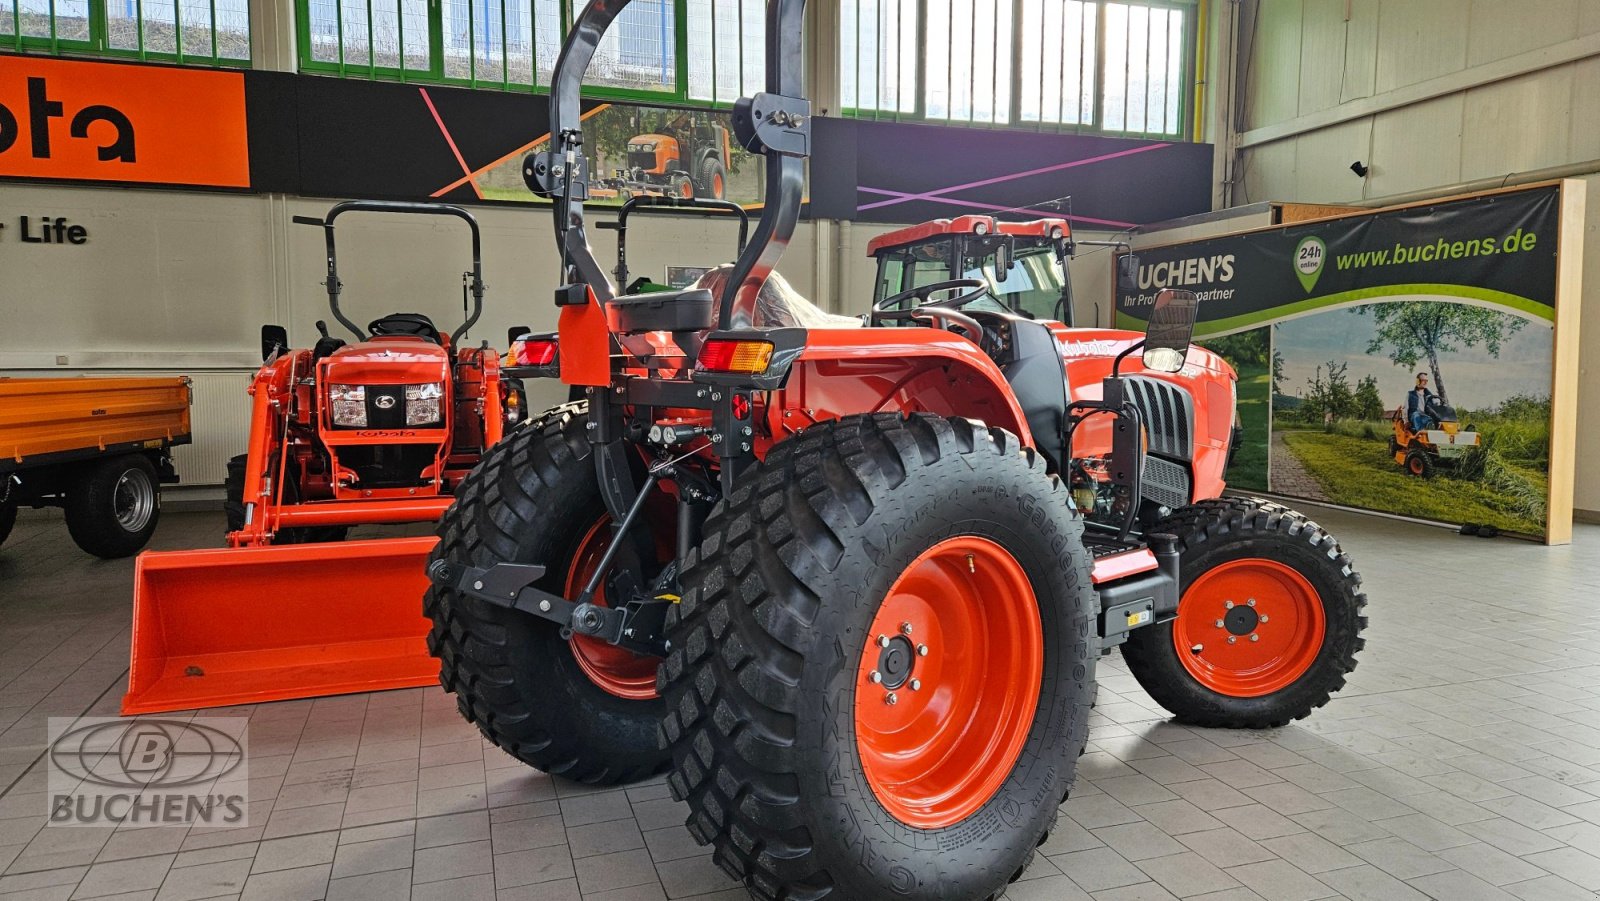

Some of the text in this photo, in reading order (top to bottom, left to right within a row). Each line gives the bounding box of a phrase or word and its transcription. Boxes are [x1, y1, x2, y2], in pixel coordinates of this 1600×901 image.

[20, 215, 88, 245] Life
[1299, 246, 1321, 260] 24h
[1336, 228, 1537, 271] www.buchens.de
[1138, 254, 1235, 290] UCHEN'S
[1300, 261, 1319, 269] online
[1124, 288, 1235, 307] Ihr Prof partner
[356, 430, 416, 438] Kubota
